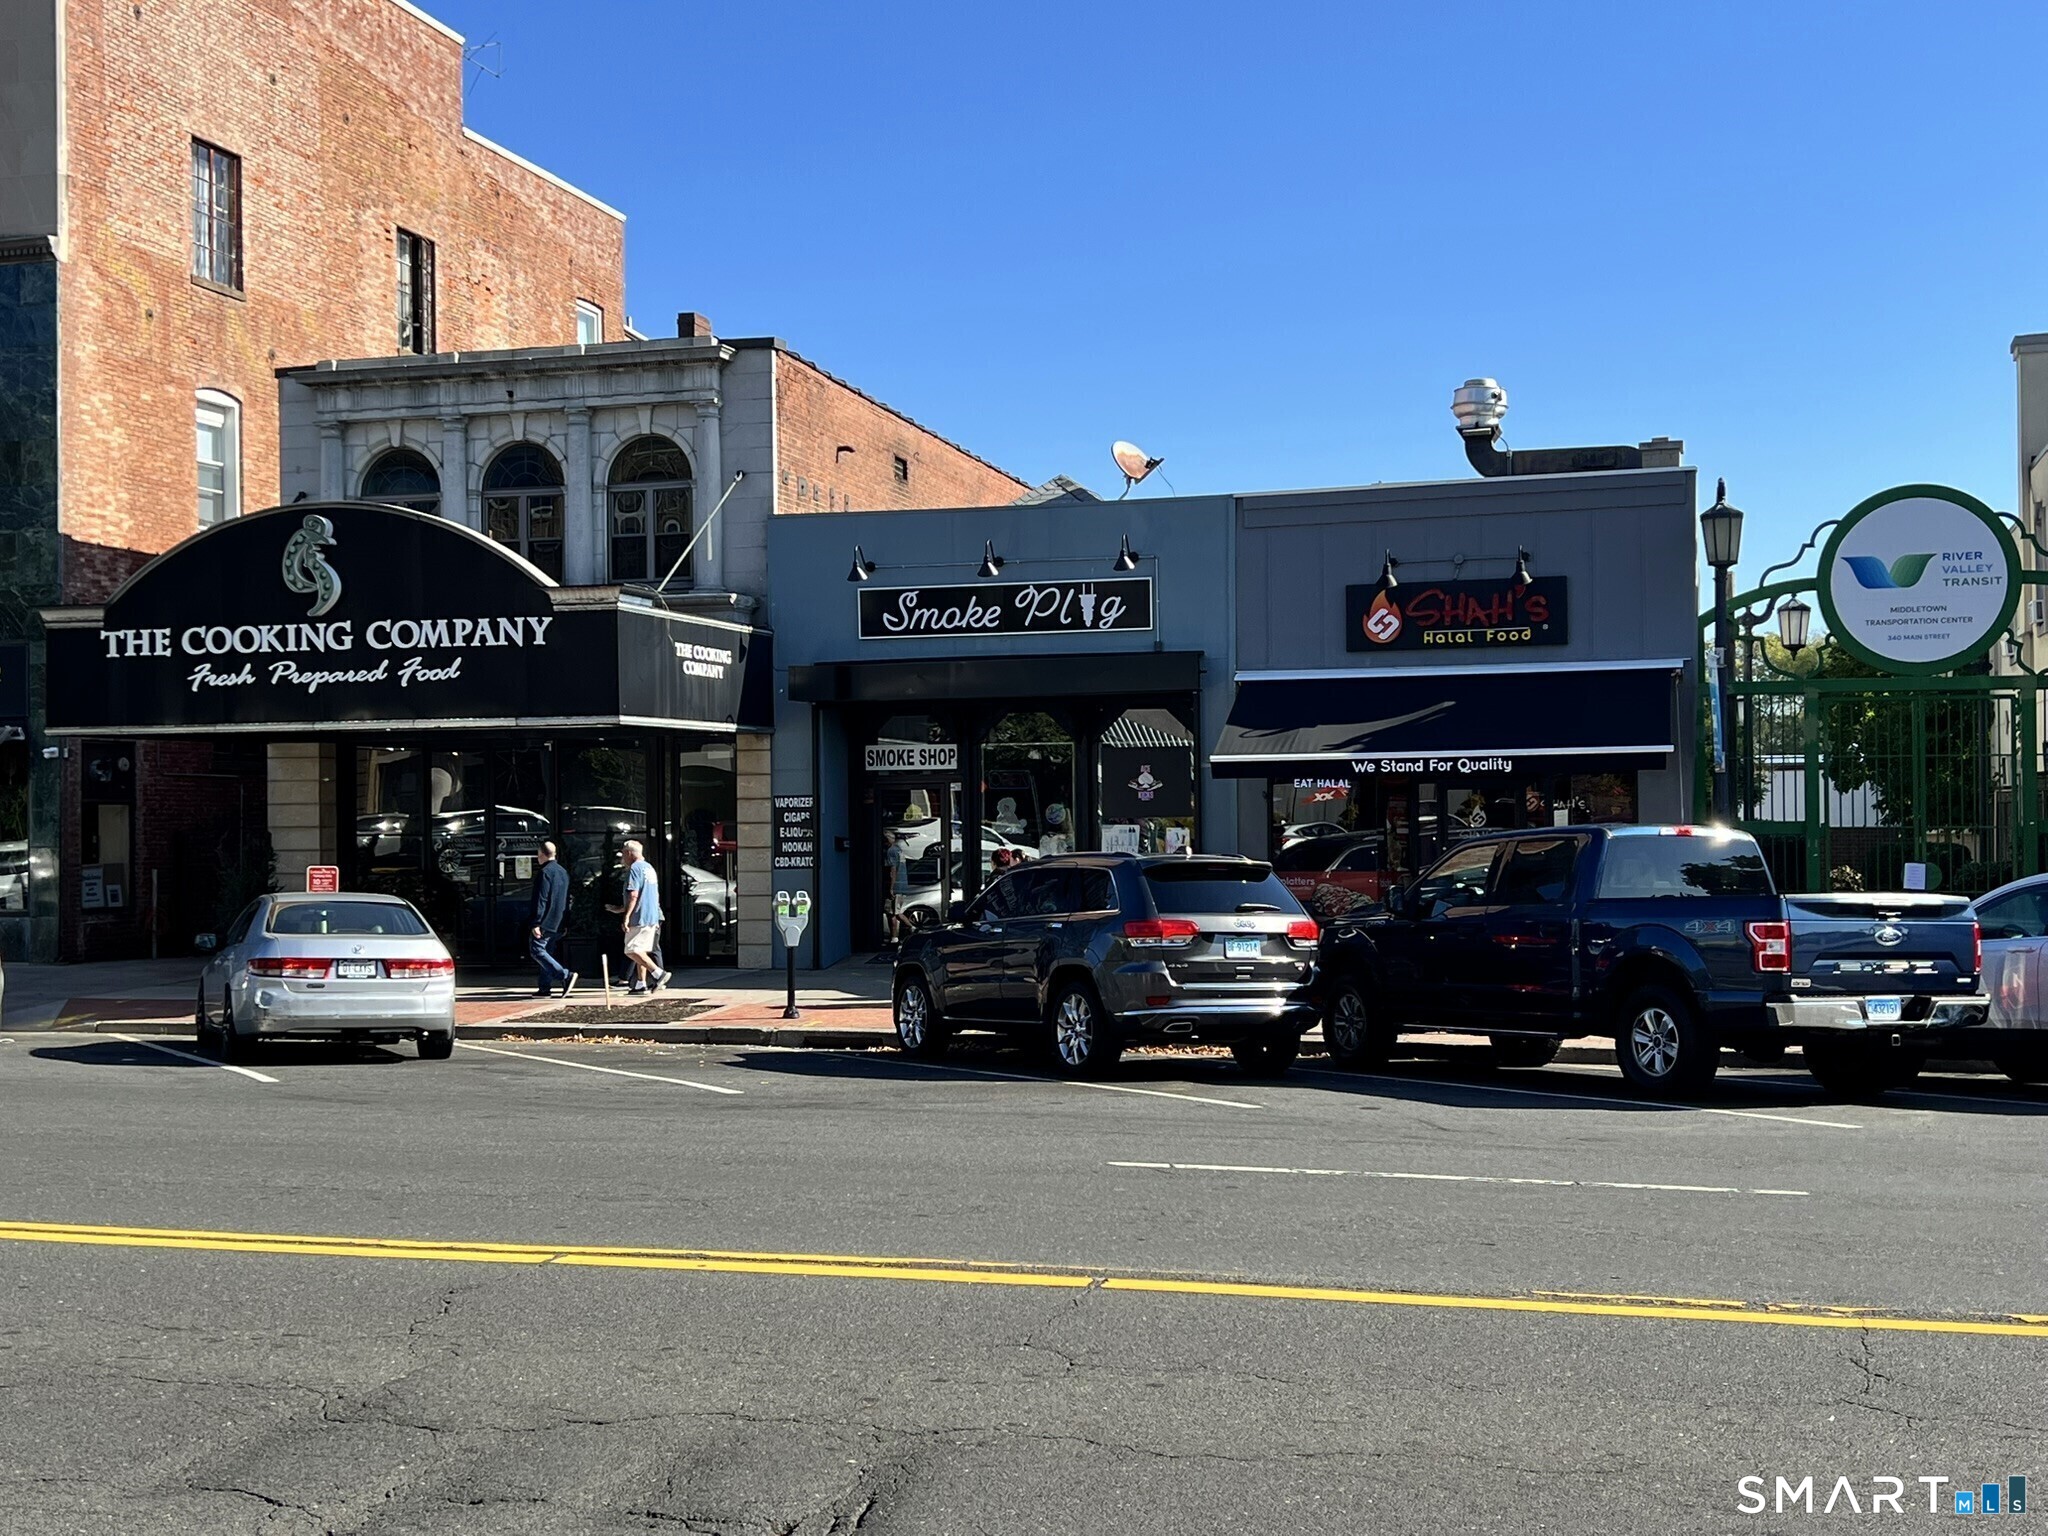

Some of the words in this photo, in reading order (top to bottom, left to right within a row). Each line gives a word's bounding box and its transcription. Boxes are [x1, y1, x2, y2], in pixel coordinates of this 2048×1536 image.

[1942, 551, 1983, 561] RIVER
[1942, 564, 1993, 574] VALLEY
[1943, 576, 2003, 587] TRANSIT
[882, 591, 1001, 631] Smoke
[1889, 605, 1947, 613] MIDDLETOWN
[1865, 617, 1938, 626] TRANSPORTATION
[1940, 616, 1973, 625] CENTER
[100, 628, 172, 658] THE
[181, 620, 354, 655] COOKING
[366, 616, 553, 650] COMPANY
[1423, 631, 1474, 644] Halal
[1486, 628, 1532, 642] Food
[674, 641, 693, 658] THE
[693, 645, 732, 664] COOKING
[187, 663, 256, 692] Fresh
[268, 659, 389, 694] Prepared
[398, 656, 462, 687] Food
[683, 661, 724, 679] COMPANY
[867, 749, 915, 767] SMOKE
[919, 748, 956, 766] SHOP
[1352, 761, 1376, 773] We
[1380, 759, 1424, 772] Stand
[1429, 759, 1453, 772] For
[1457, 758, 1512, 773] Quality
[1294, 779, 1313, 788] EAT
[1317, 779, 1351, 788] HALAL
[782, 842, 813, 852] HOOKAH
